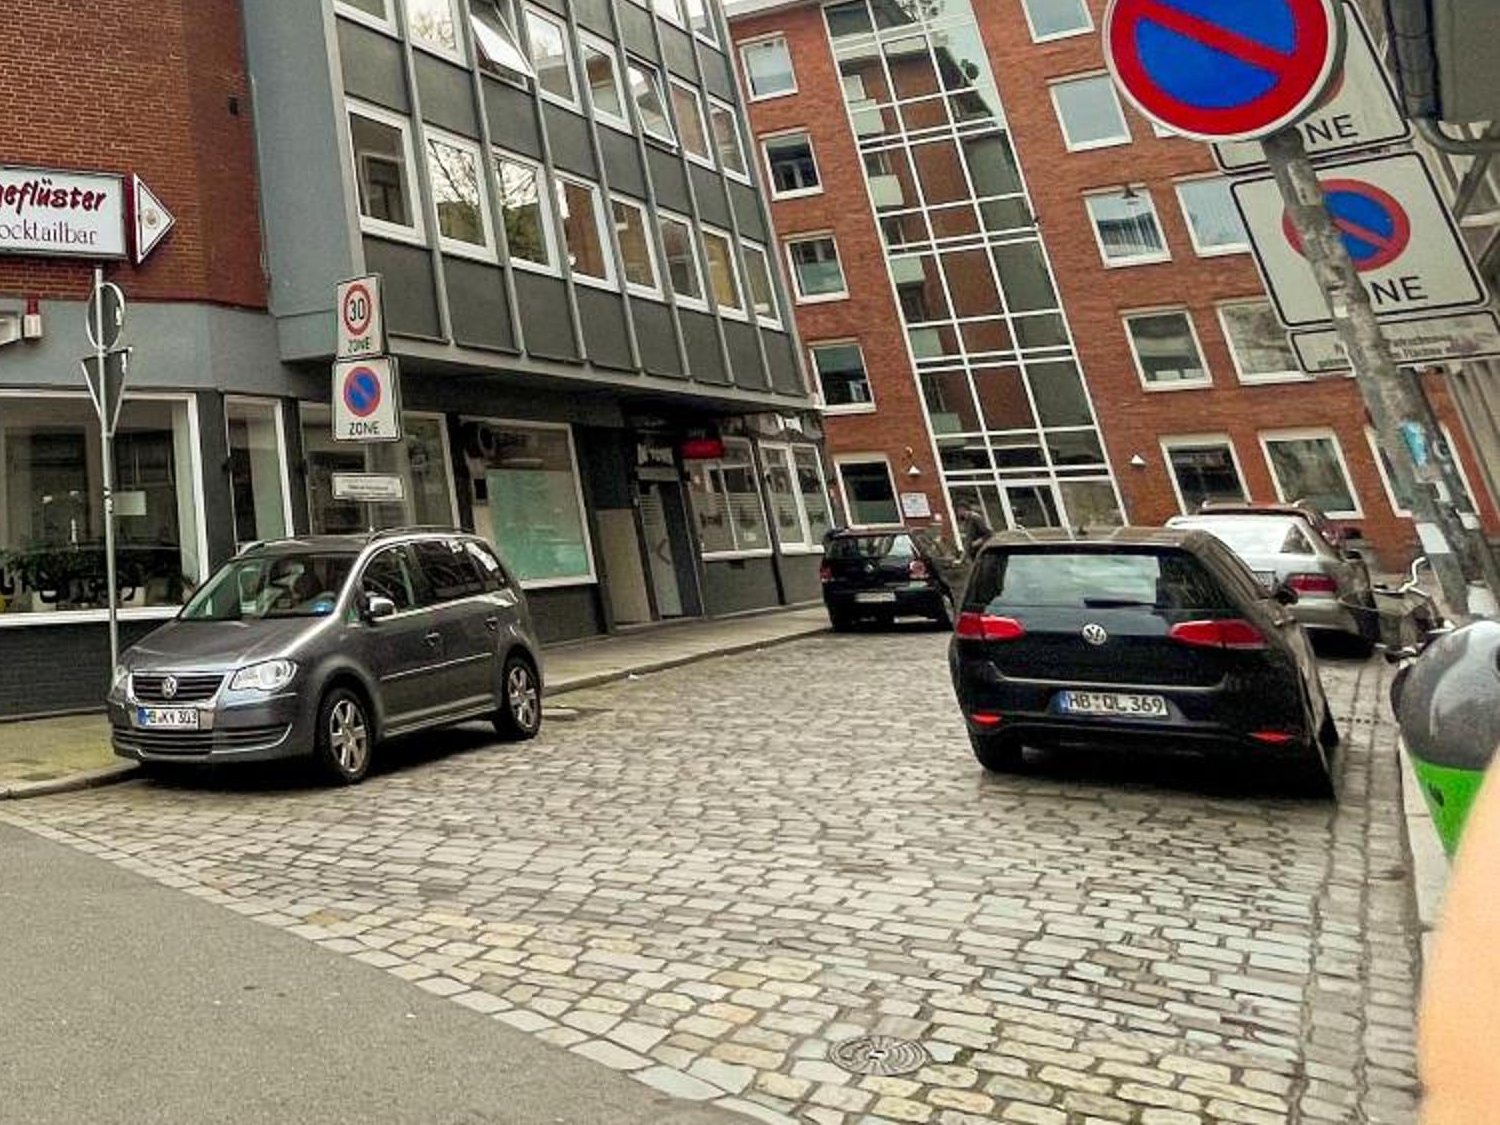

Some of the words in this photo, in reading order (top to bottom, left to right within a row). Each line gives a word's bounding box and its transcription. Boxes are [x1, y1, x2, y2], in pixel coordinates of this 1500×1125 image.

[1304, 114, 1359, 144] NE
[1370, 275, 1428, 305] NE
[349, 297, 366, 322] 30
[348, 336, 371, 353] ZONE
[349, 420, 381, 436] ZONE
[1129, 696, 1163, 714] 369
